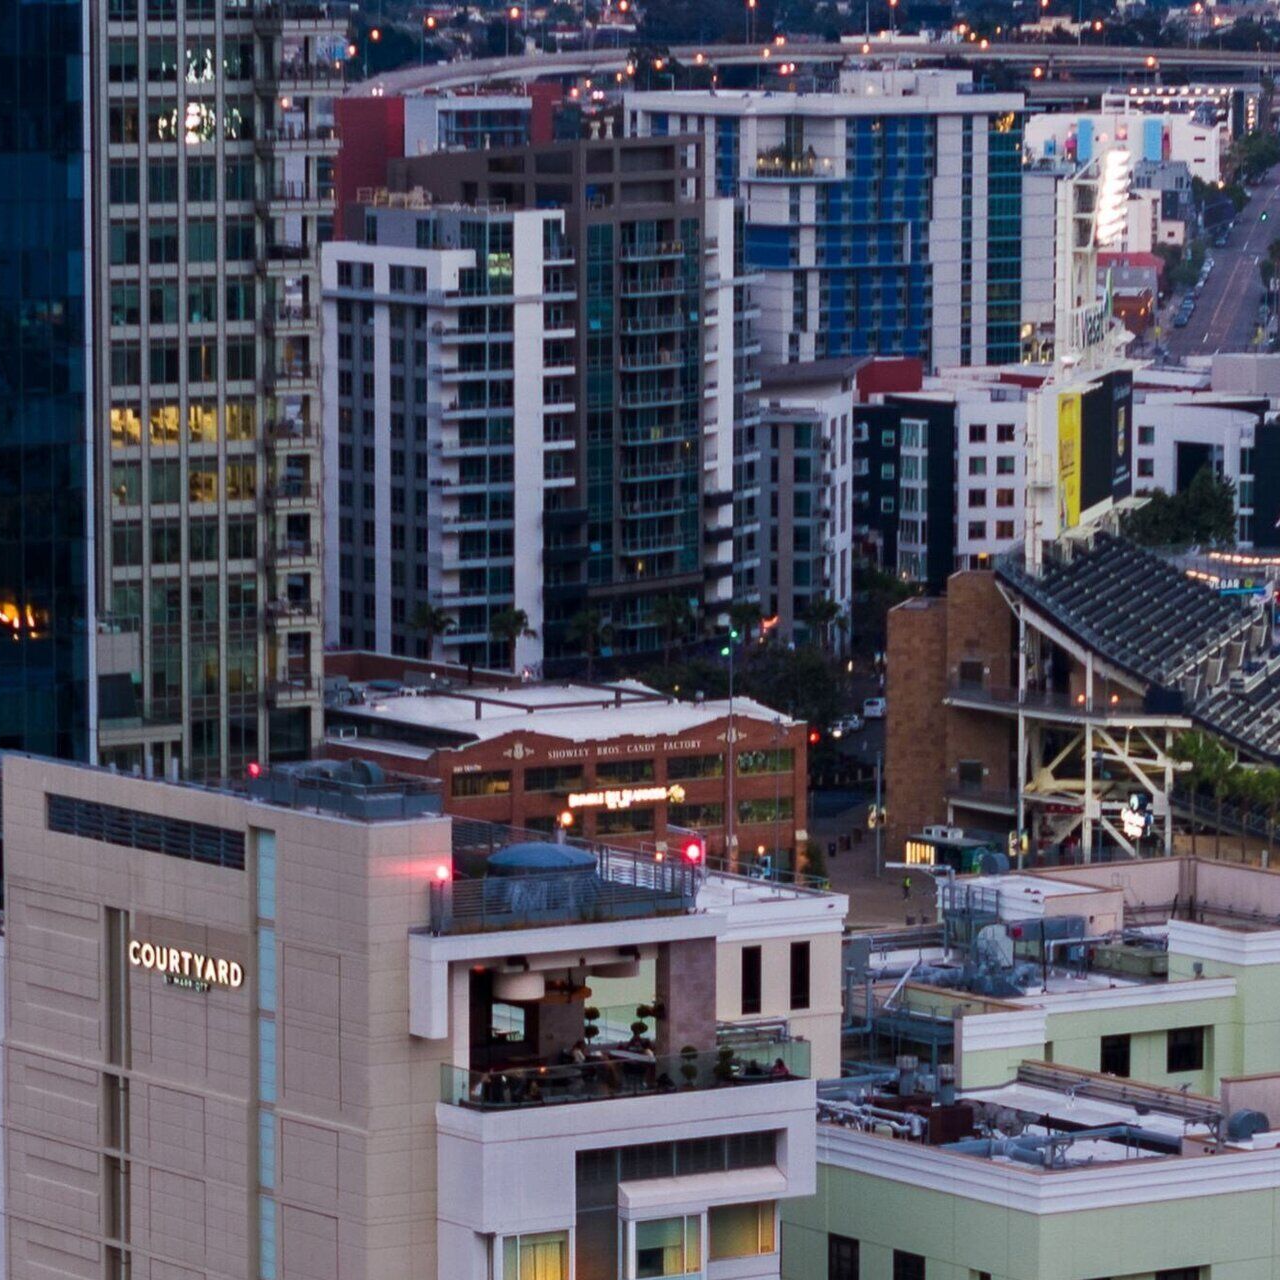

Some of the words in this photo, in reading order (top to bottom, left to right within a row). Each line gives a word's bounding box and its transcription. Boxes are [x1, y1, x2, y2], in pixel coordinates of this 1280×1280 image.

[548, 749, 589, 760] SHOWLEY
[627, 744, 656, 753] CANDY
[664, 740, 701, 750] FACTORY
[129, 940, 244, 989] COURTYARD
